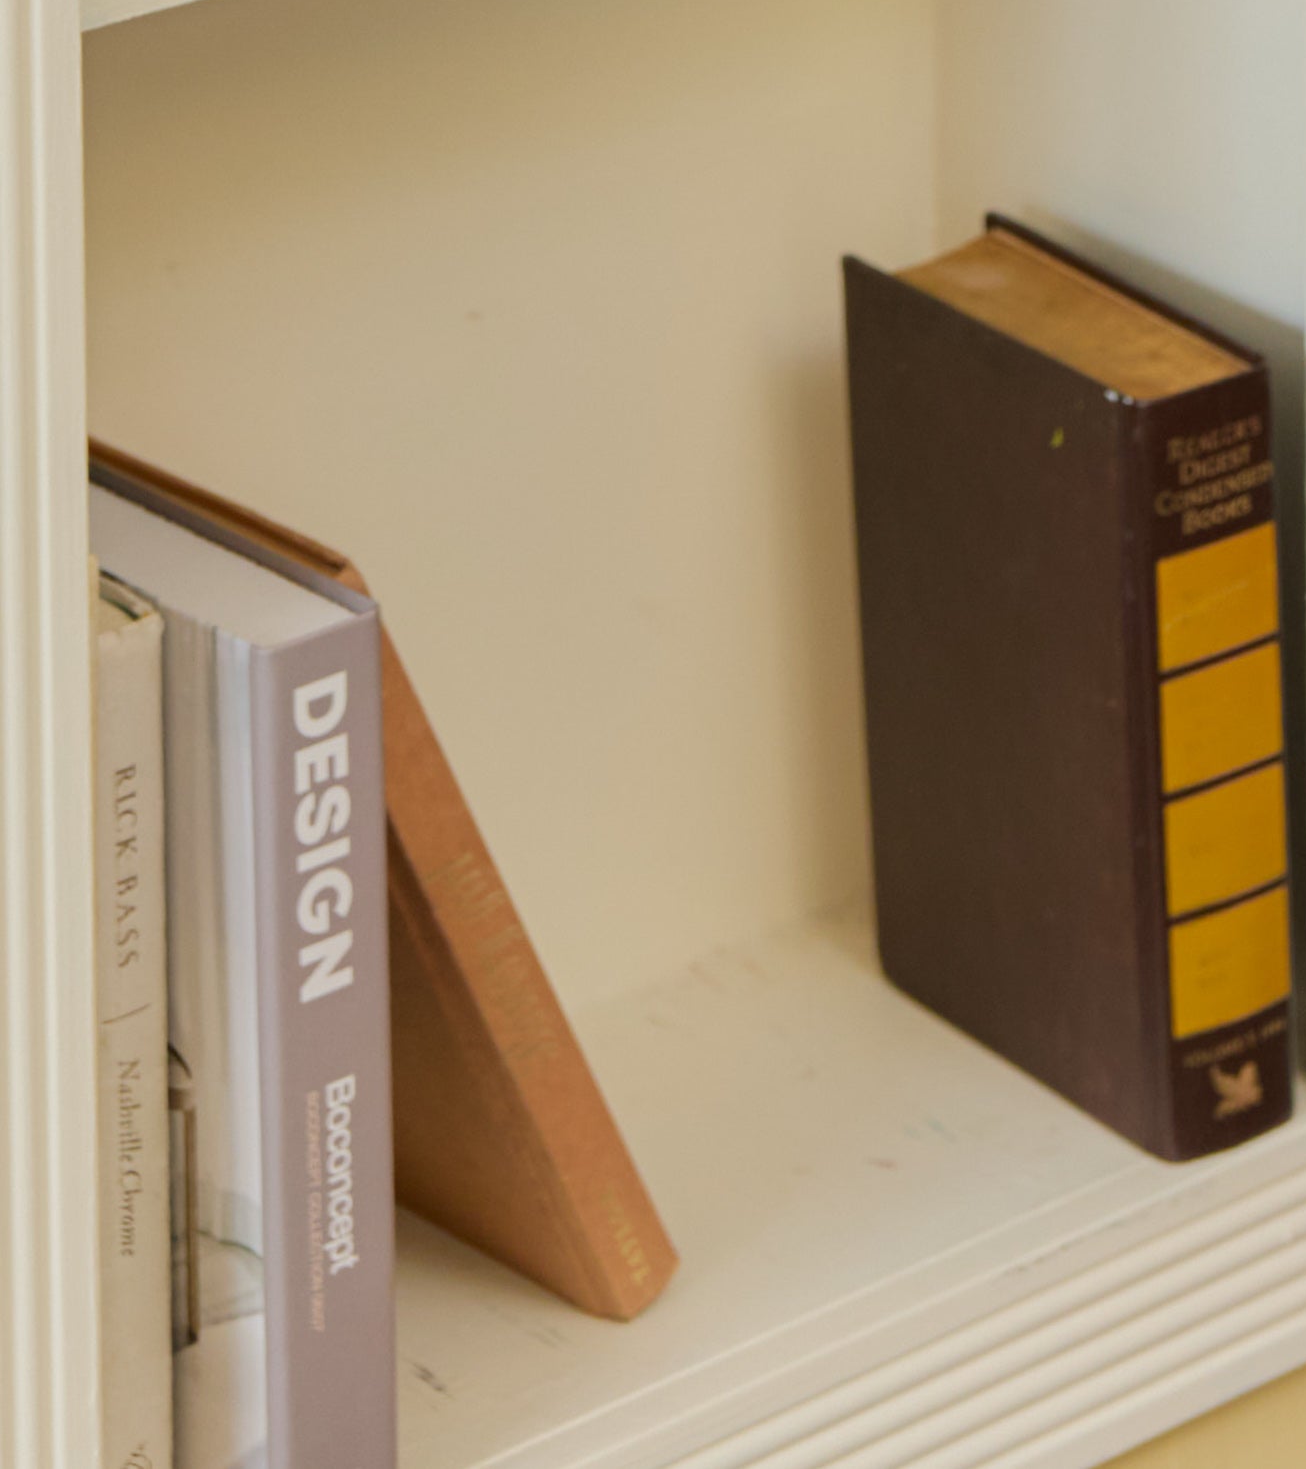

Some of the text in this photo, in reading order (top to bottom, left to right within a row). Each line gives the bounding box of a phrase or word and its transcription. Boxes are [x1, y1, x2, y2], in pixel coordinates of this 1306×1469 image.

[1154, 460, 1274, 518] CONDENSED
[1178, 443, 1252, 486] DIGEST
[1182, 494, 1252, 536] BOOKS
[110, 763, 141, 971] RICK BASS
[292, 669, 355, 1005] DESIGN
[116, 1057, 143, 1259] Nashville Chrome
[323, 1072, 359, 1276] Boconcept
